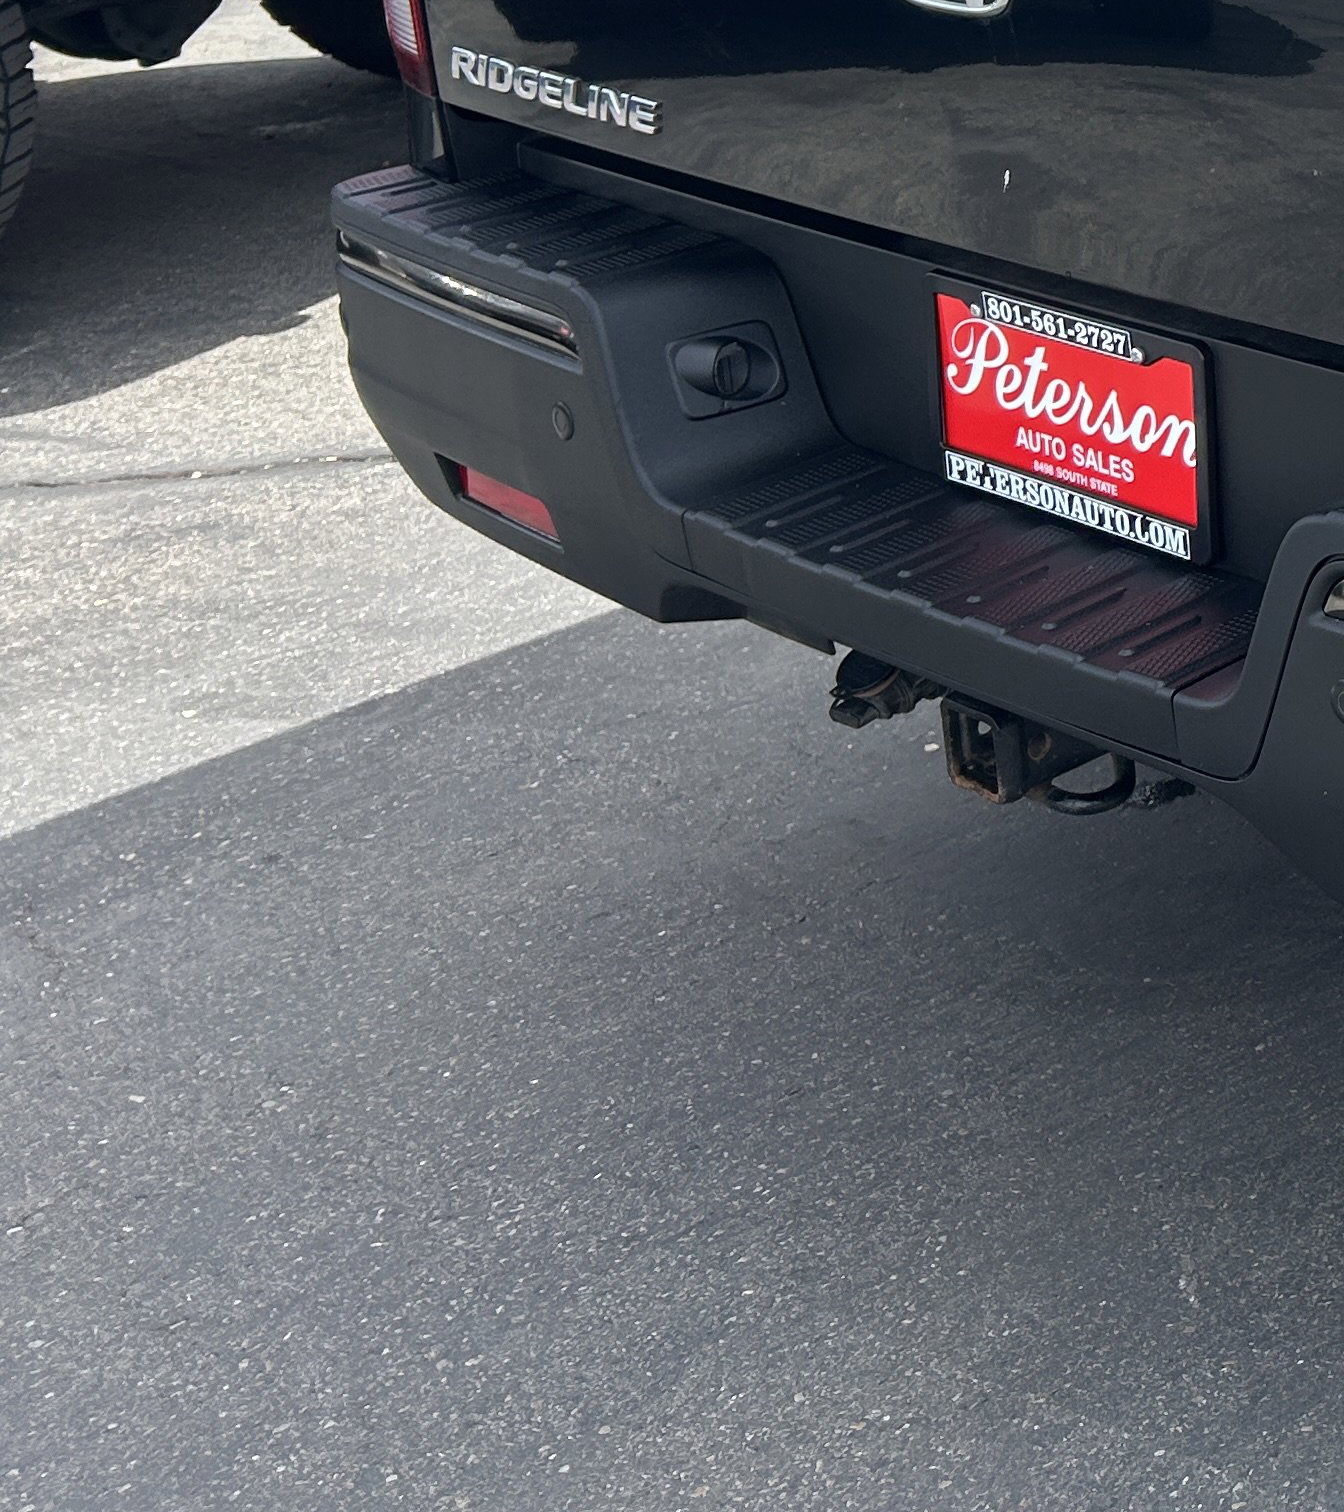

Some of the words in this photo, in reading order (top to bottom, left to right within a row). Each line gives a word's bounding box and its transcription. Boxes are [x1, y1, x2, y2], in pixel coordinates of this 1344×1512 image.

[451, 46, 663, 135] RIDGELINE
[987, 297, 1127, 355] 801-561-2727
[946, 317, 1197, 468] Peterson
[1016, 426, 1067, 461] AUTO
[1072, 443, 1135, 483] SALES
[1055, 466, 1088, 487] SOUTH
[1089, 477, 1119, 497] STATE
